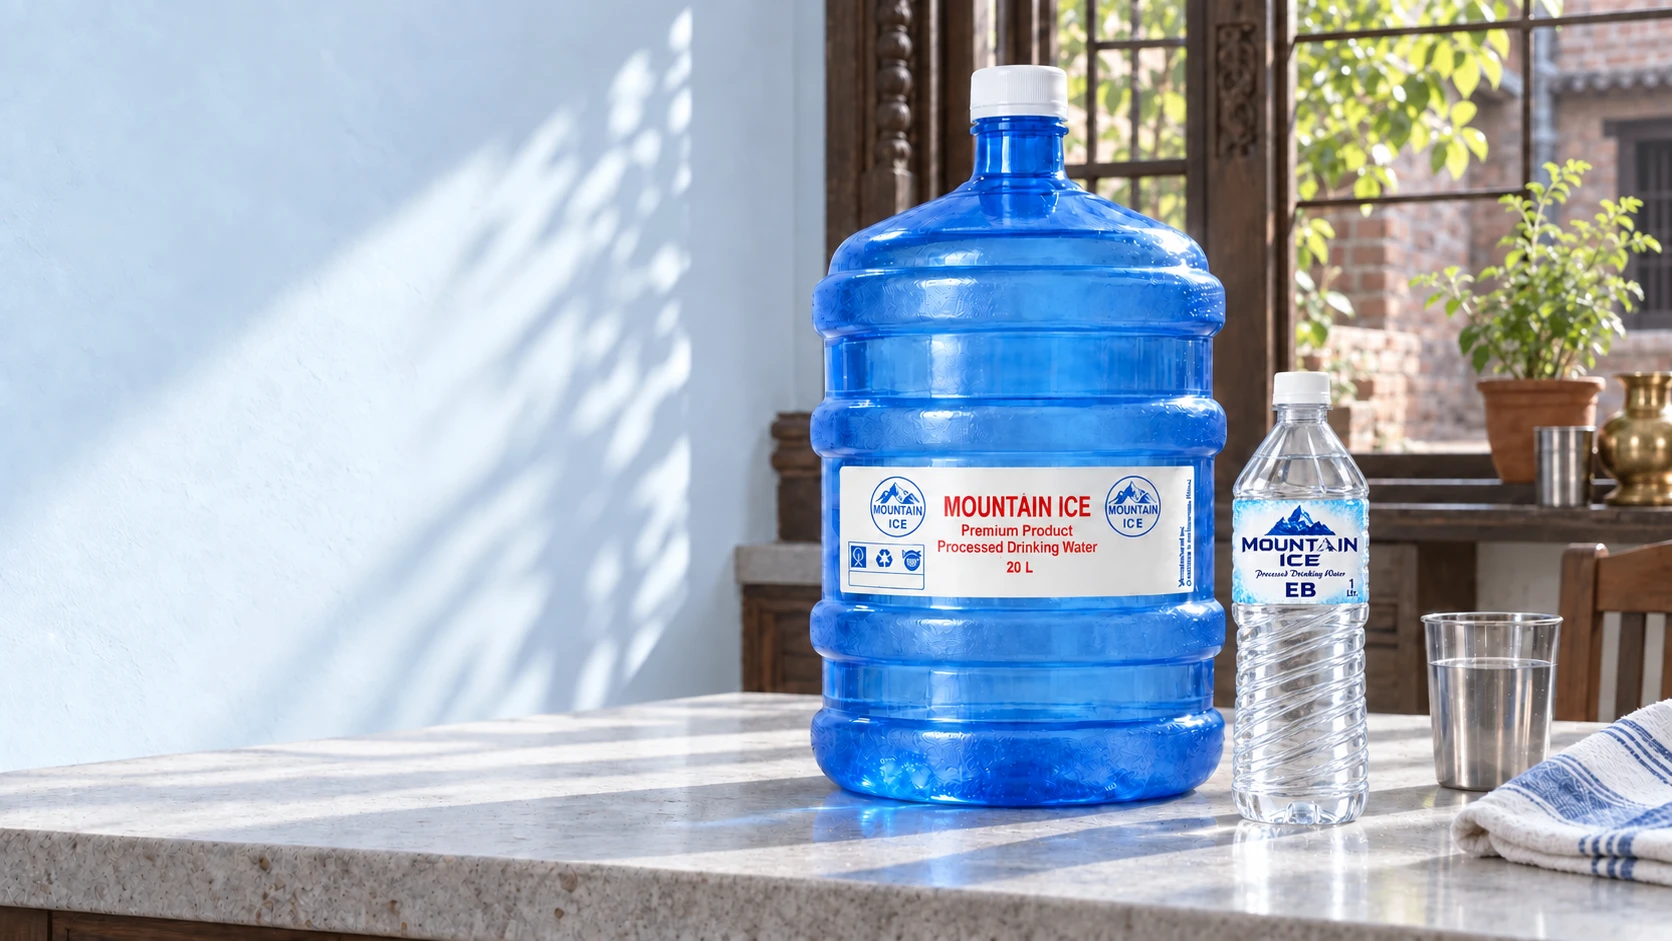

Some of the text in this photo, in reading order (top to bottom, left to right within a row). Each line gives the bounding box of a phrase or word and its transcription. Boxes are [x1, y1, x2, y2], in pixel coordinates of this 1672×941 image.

[873, 504, 923, 517] MOUNTAIN
[944, 494, 1091, 518] MOUNTAIN ICE
[1108, 504, 1158, 517] MOUNTAIN
[888, 519, 907, 530] ICE
[1123, 518, 1143, 529] ICE
[961, 524, 1073, 537] Premium Product
[937, 540, 1098, 556] Processed Drinking Water
[1241, 537, 1358, 553] MOUNTAIN
[1279, 553, 1321, 567] ICE
[1006, 561, 1033, 574] 20 L
[1289, 569, 1323, 579] Drinking
[1324, 569, 1345, 577] Water
[1285, 582, 1316, 598] EB
[1348, 578, 1354, 589] 1
